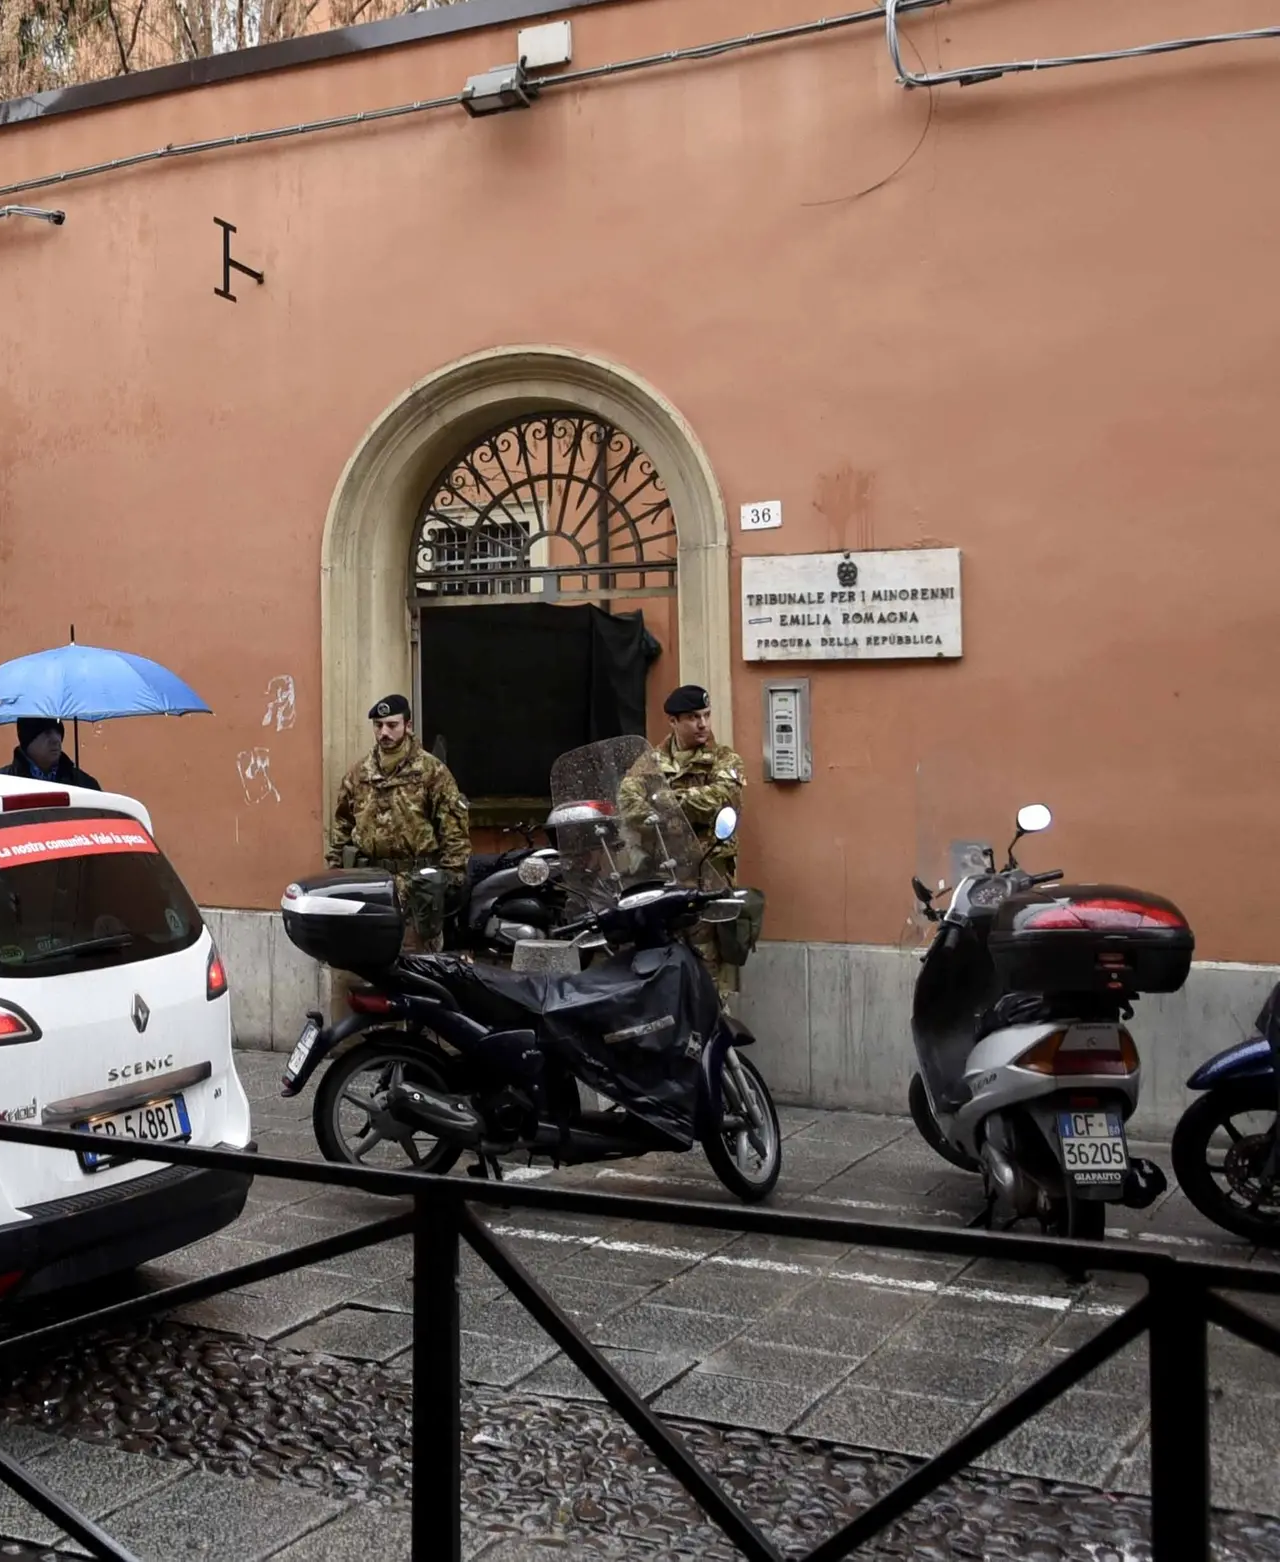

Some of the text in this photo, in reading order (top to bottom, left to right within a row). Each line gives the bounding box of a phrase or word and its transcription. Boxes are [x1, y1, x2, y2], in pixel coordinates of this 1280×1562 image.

[751, 507, 771, 523] 36
[746, 591, 825, 607] TRIBUNALE
[830, 590, 856, 604] PER
[871, 587, 956, 602] MINORENNI
[779, 611, 919, 627] EMILIA ROMAGNA
[756, 634, 943, 649] PROCURA DELLA REPUBBLICA
[11, 841, 47, 856] nostra
[90, 833, 113, 845] Vale
[110, 832, 122, 844] la
[108, 1054, 173, 1082] SCENIC
[1073, 1114, 1095, 1136] CF
[1065, 1142, 1124, 1165] 36205
